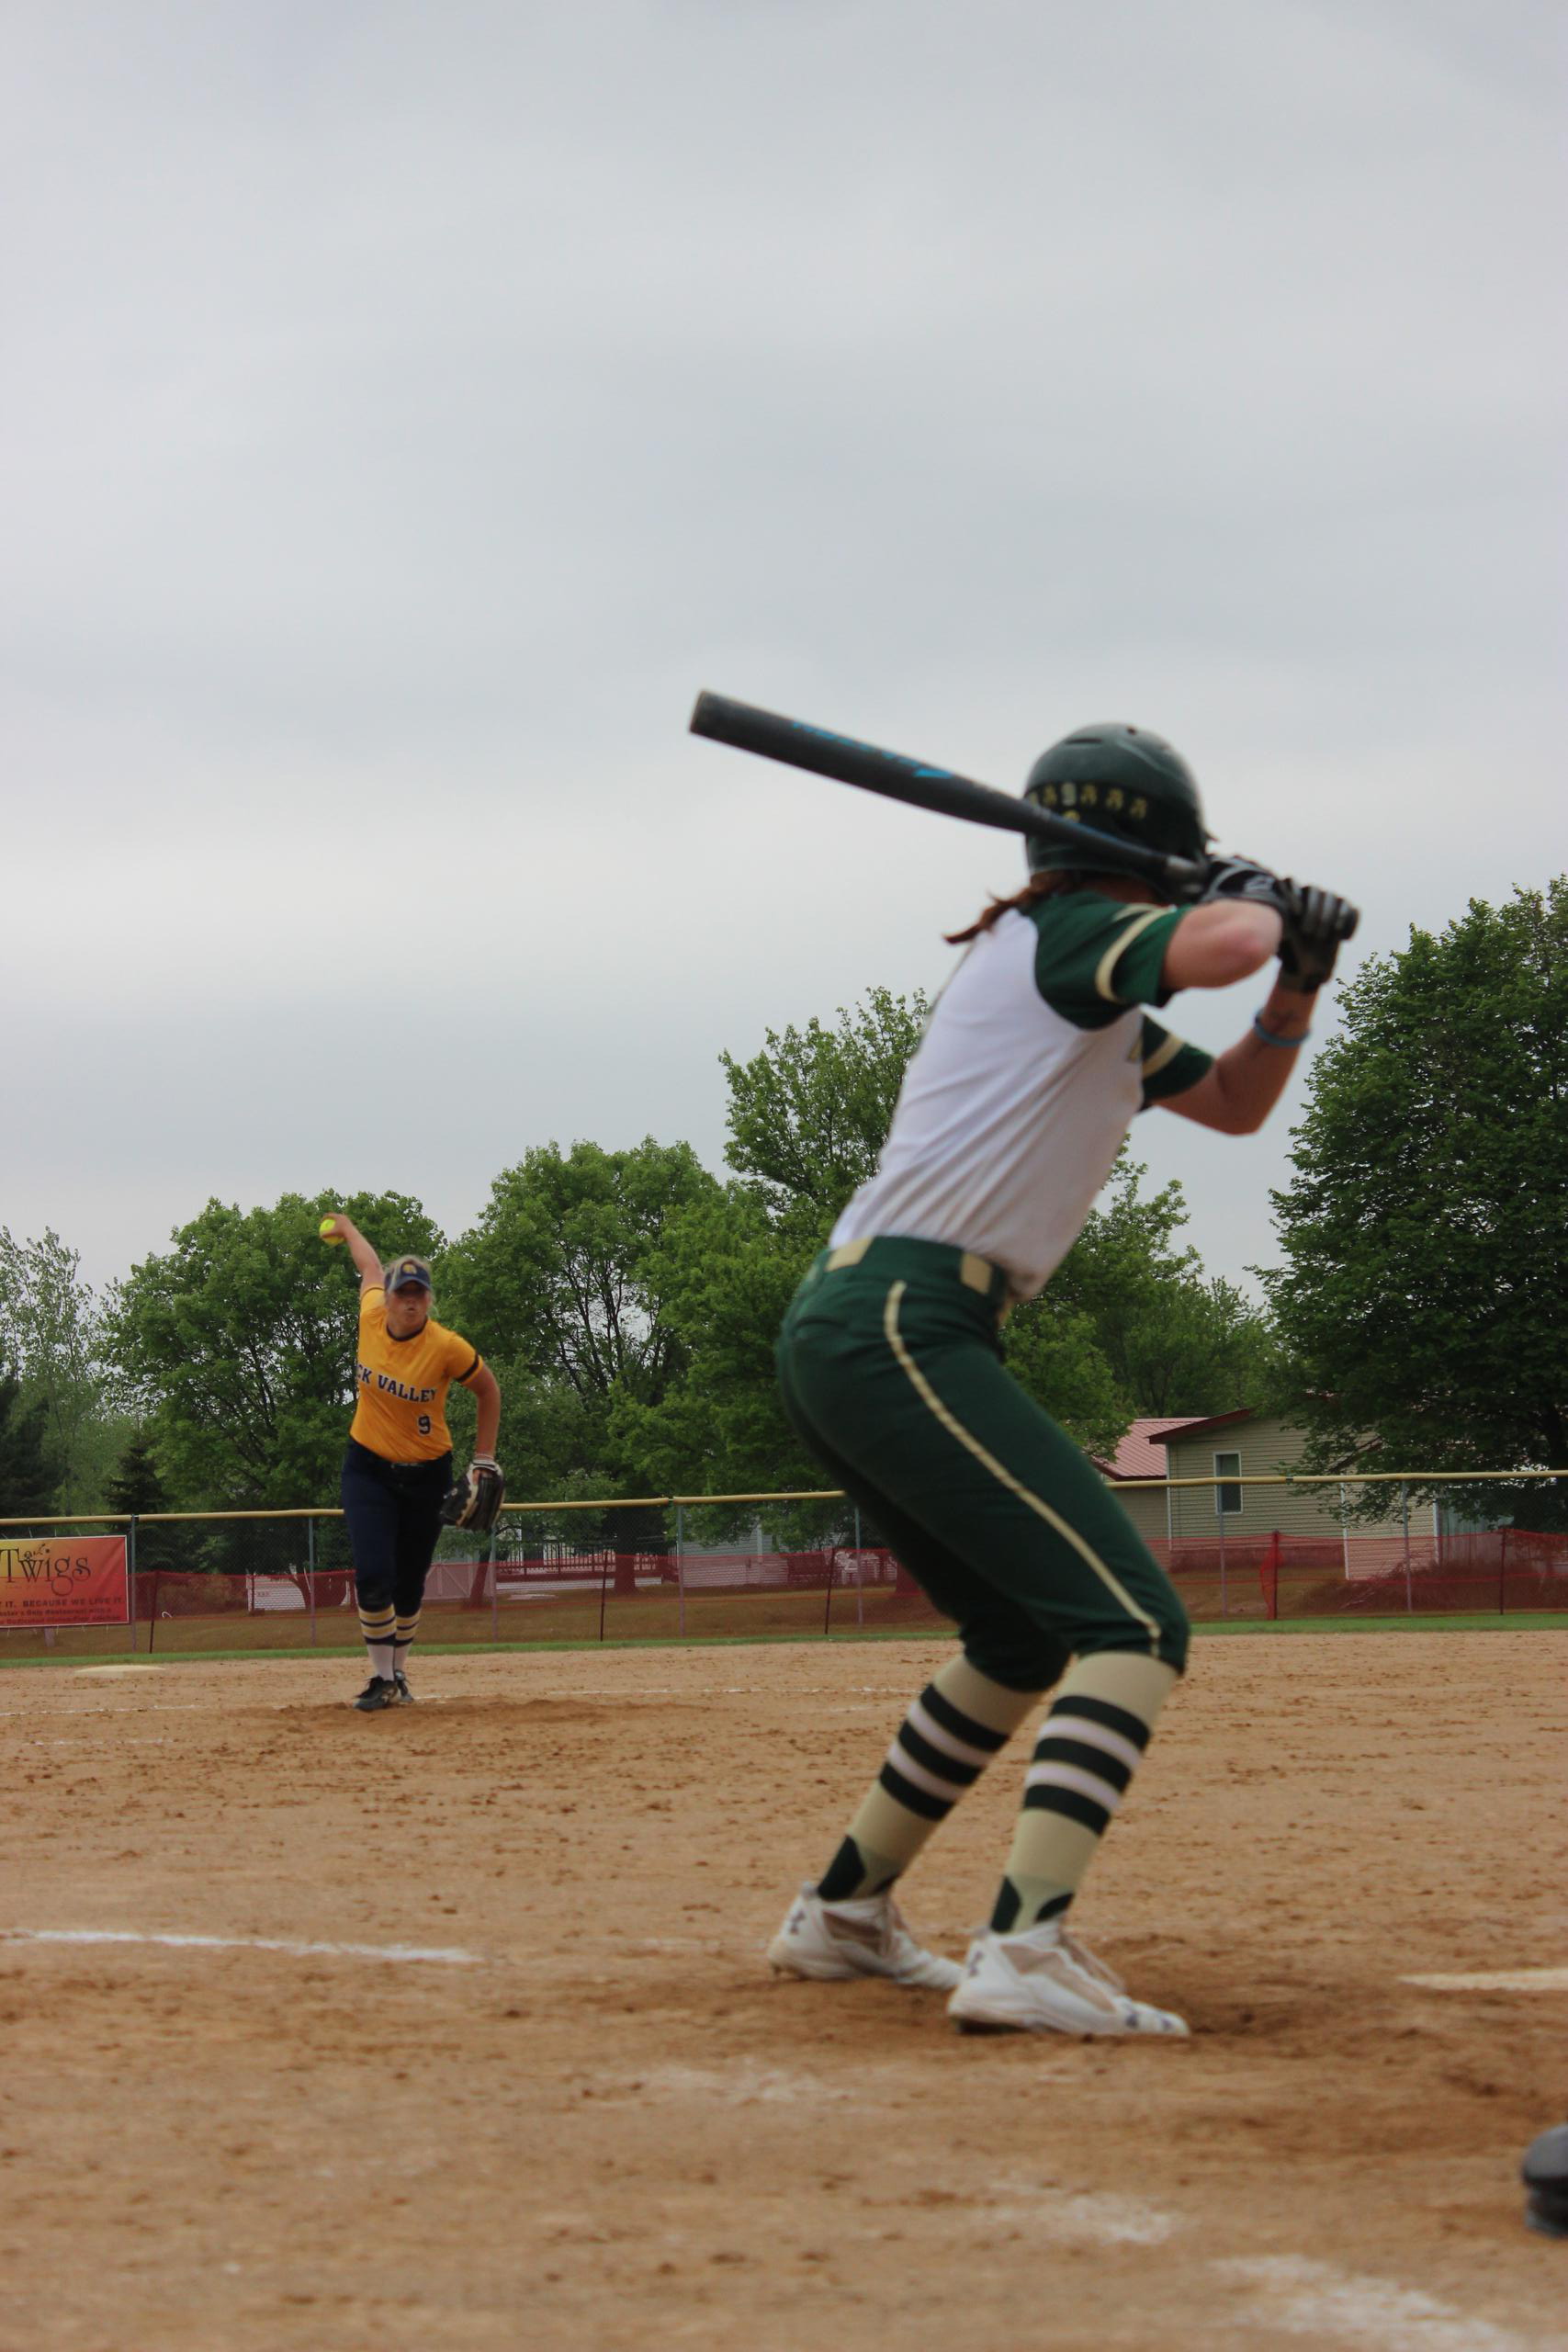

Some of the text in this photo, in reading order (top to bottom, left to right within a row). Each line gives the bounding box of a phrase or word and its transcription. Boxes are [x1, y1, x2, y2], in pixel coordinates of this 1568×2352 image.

[378, 1374, 436, 1402] VALLEY
[418, 1415, 431, 1434] 9
[0, 1548, 91, 1596] Twigs
[23, 1599, 67, 1608] BECAUSE
[71, 1598, 85, 1606] WE
